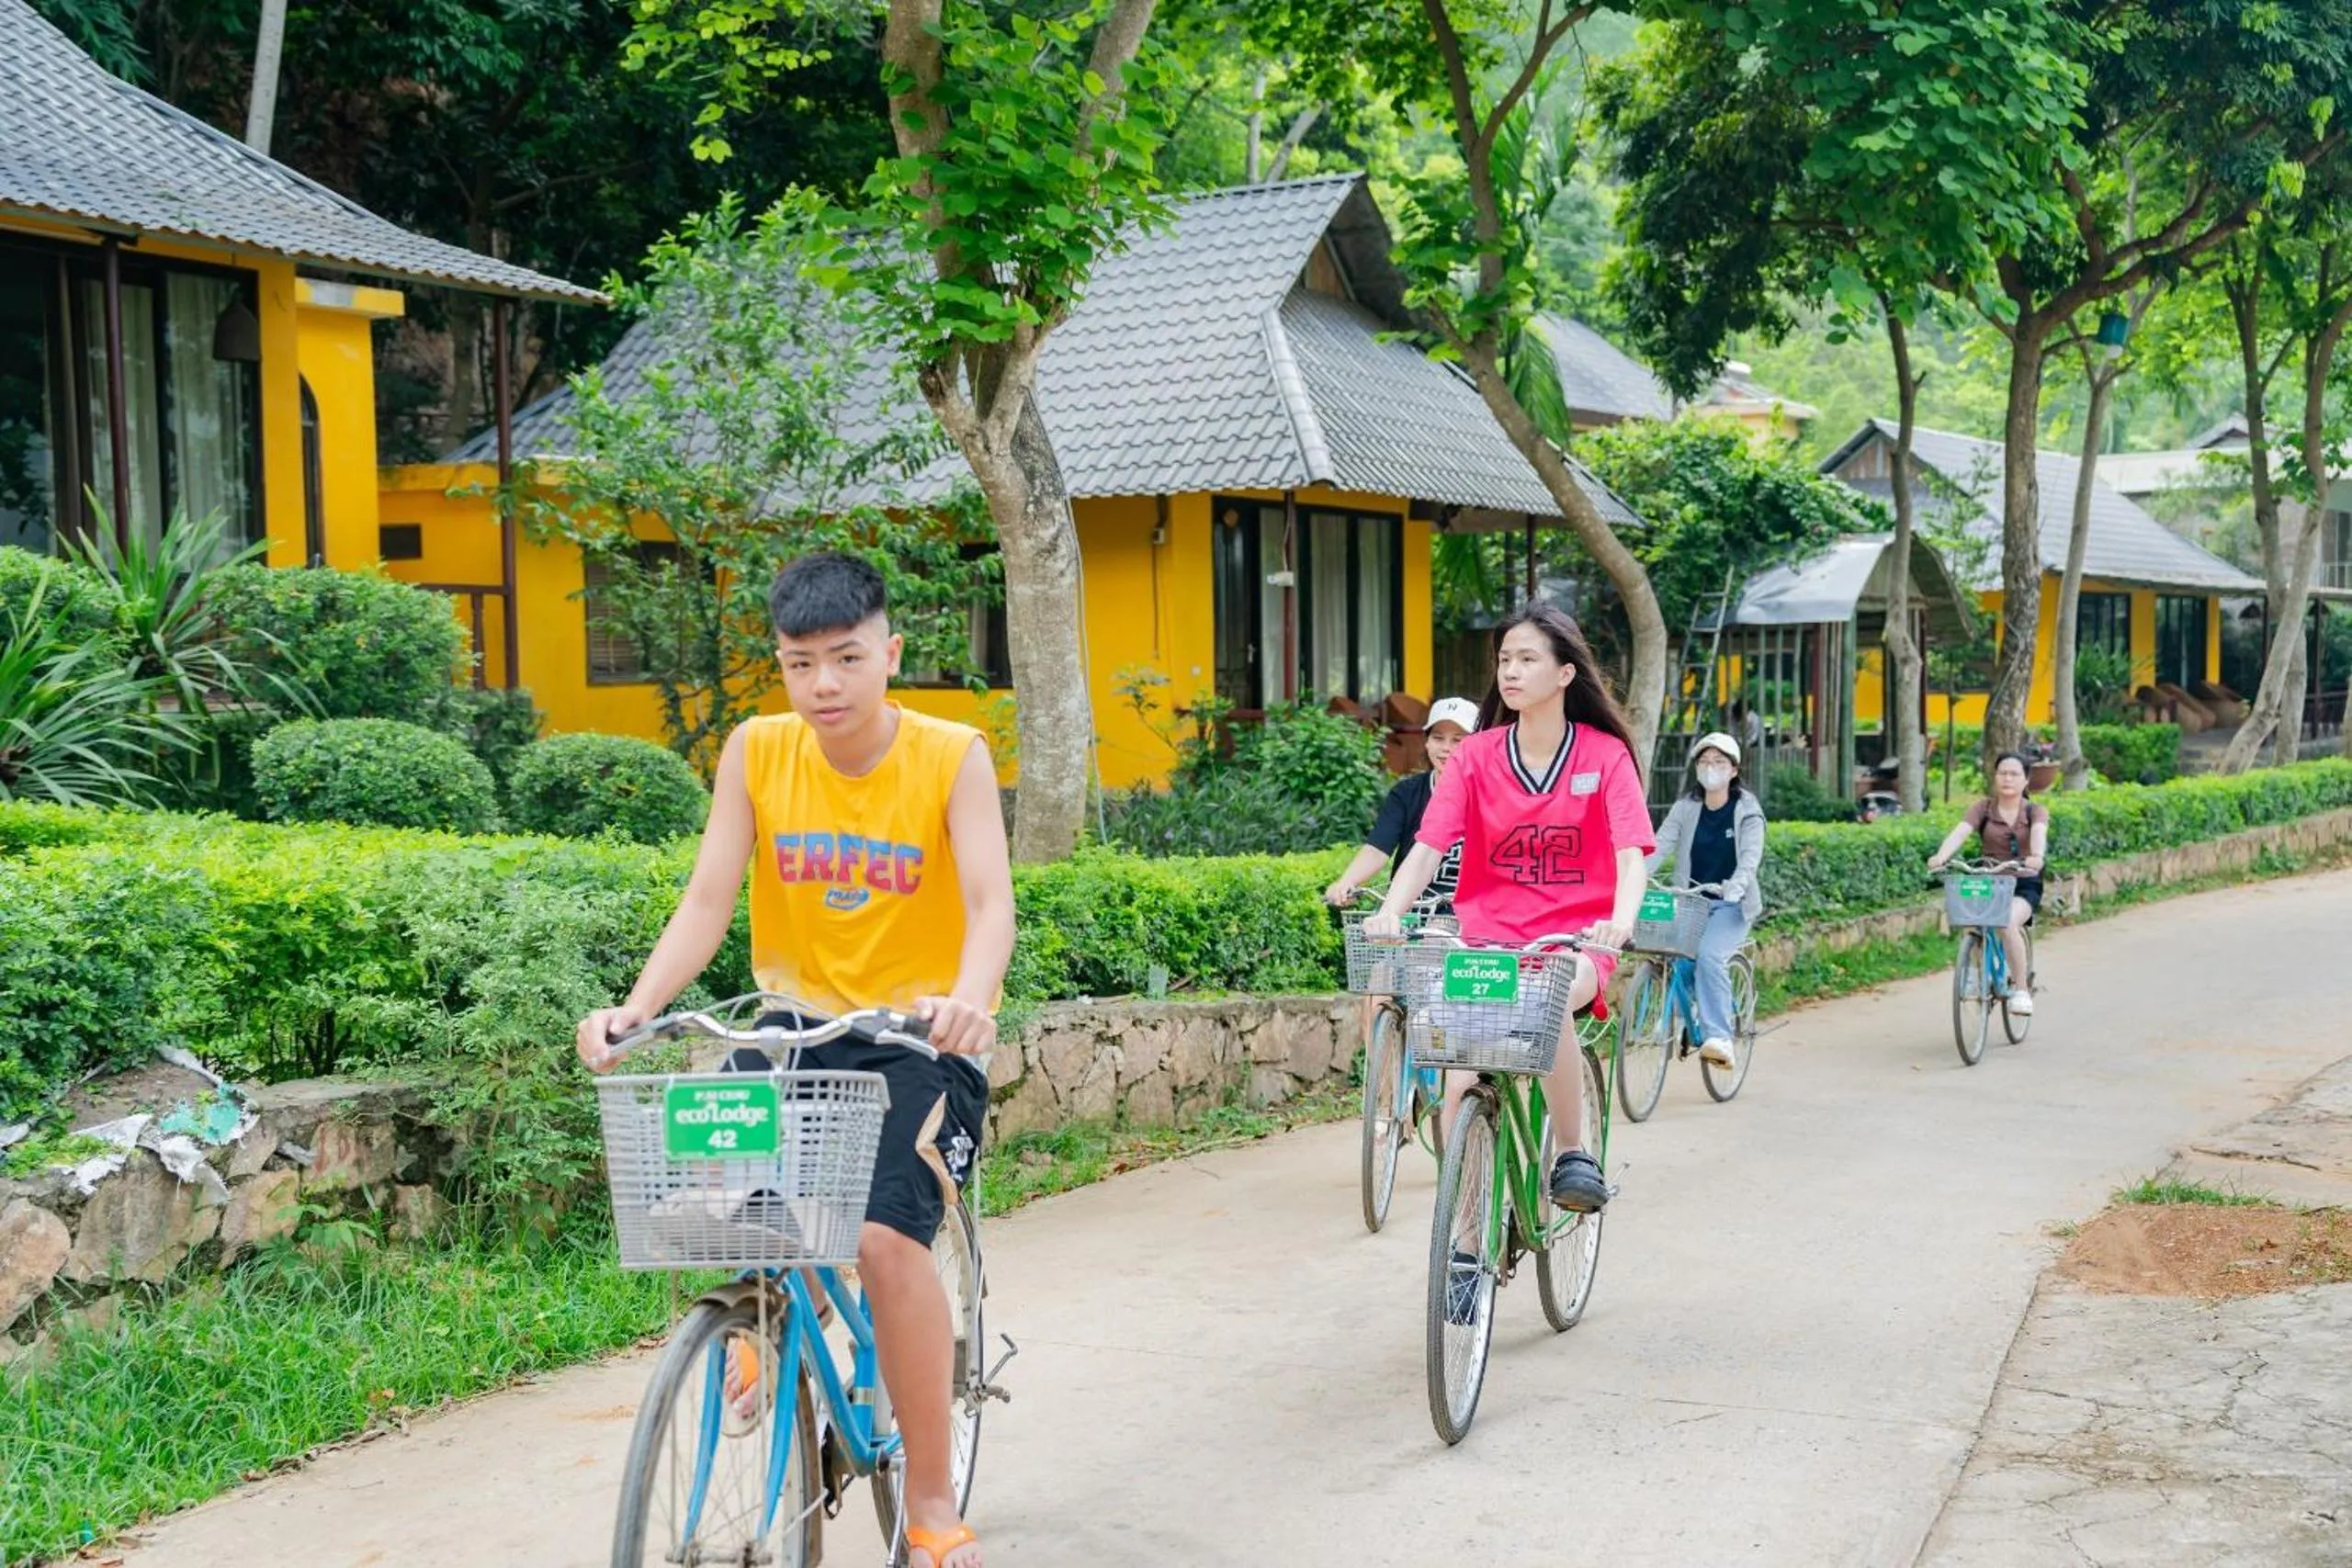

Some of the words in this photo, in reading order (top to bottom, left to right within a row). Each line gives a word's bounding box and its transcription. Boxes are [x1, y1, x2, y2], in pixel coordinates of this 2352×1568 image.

[774, 831, 924, 895] ERFEC
[1490, 825, 1584, 885] 42
[1472, 983, 1490, 995] 27
[707, 1129, 738, 1148] 42
